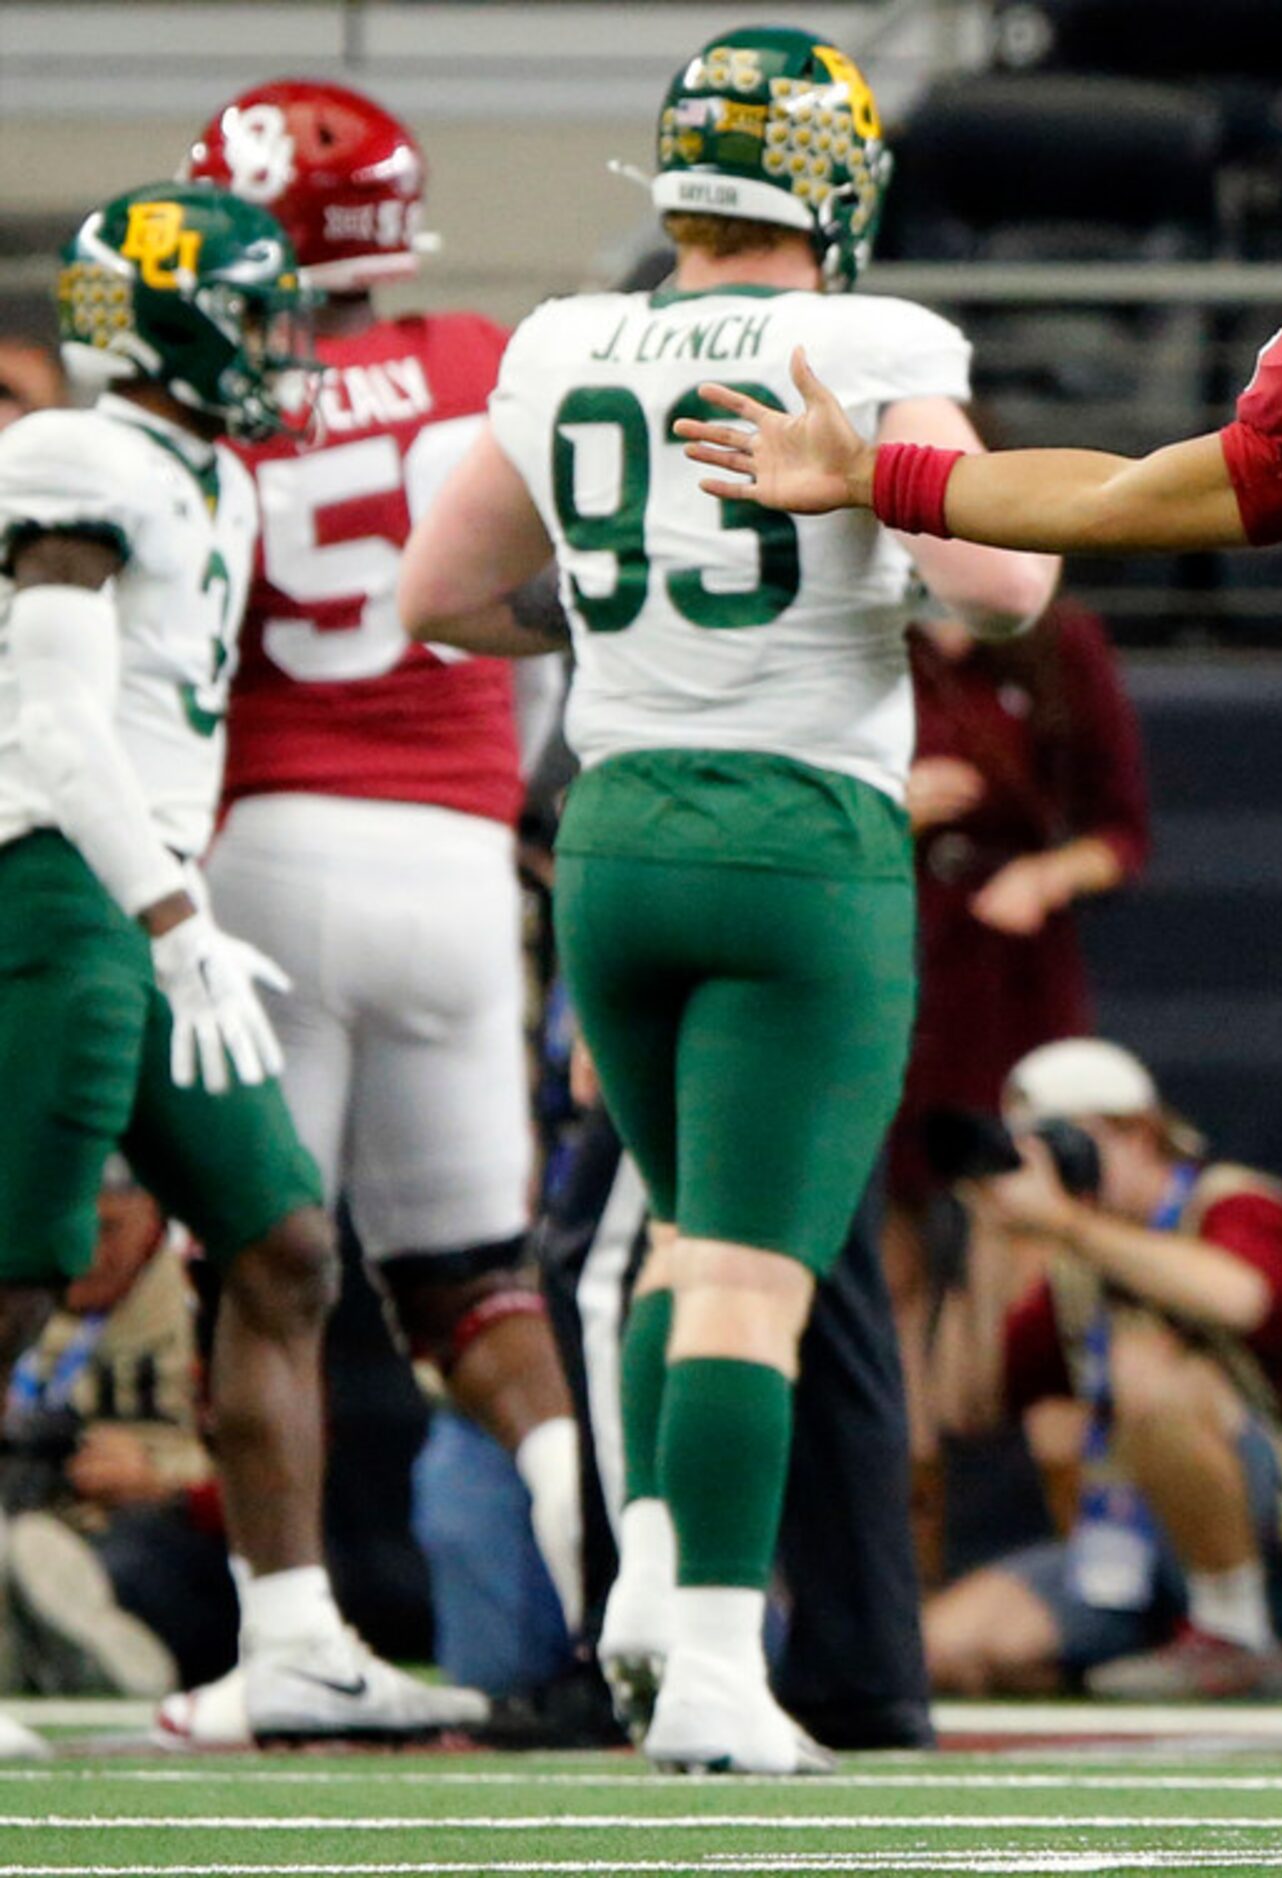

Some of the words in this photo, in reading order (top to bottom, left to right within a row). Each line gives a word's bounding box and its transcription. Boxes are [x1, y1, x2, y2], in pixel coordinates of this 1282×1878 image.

[120, 201, 204, 289] BU
[589, 314, 627, 361] J.
[635, 313, 771, 361] LYNCH
[304, 356, 432, 432] EALY
[552, 381, 801, 633] 93
